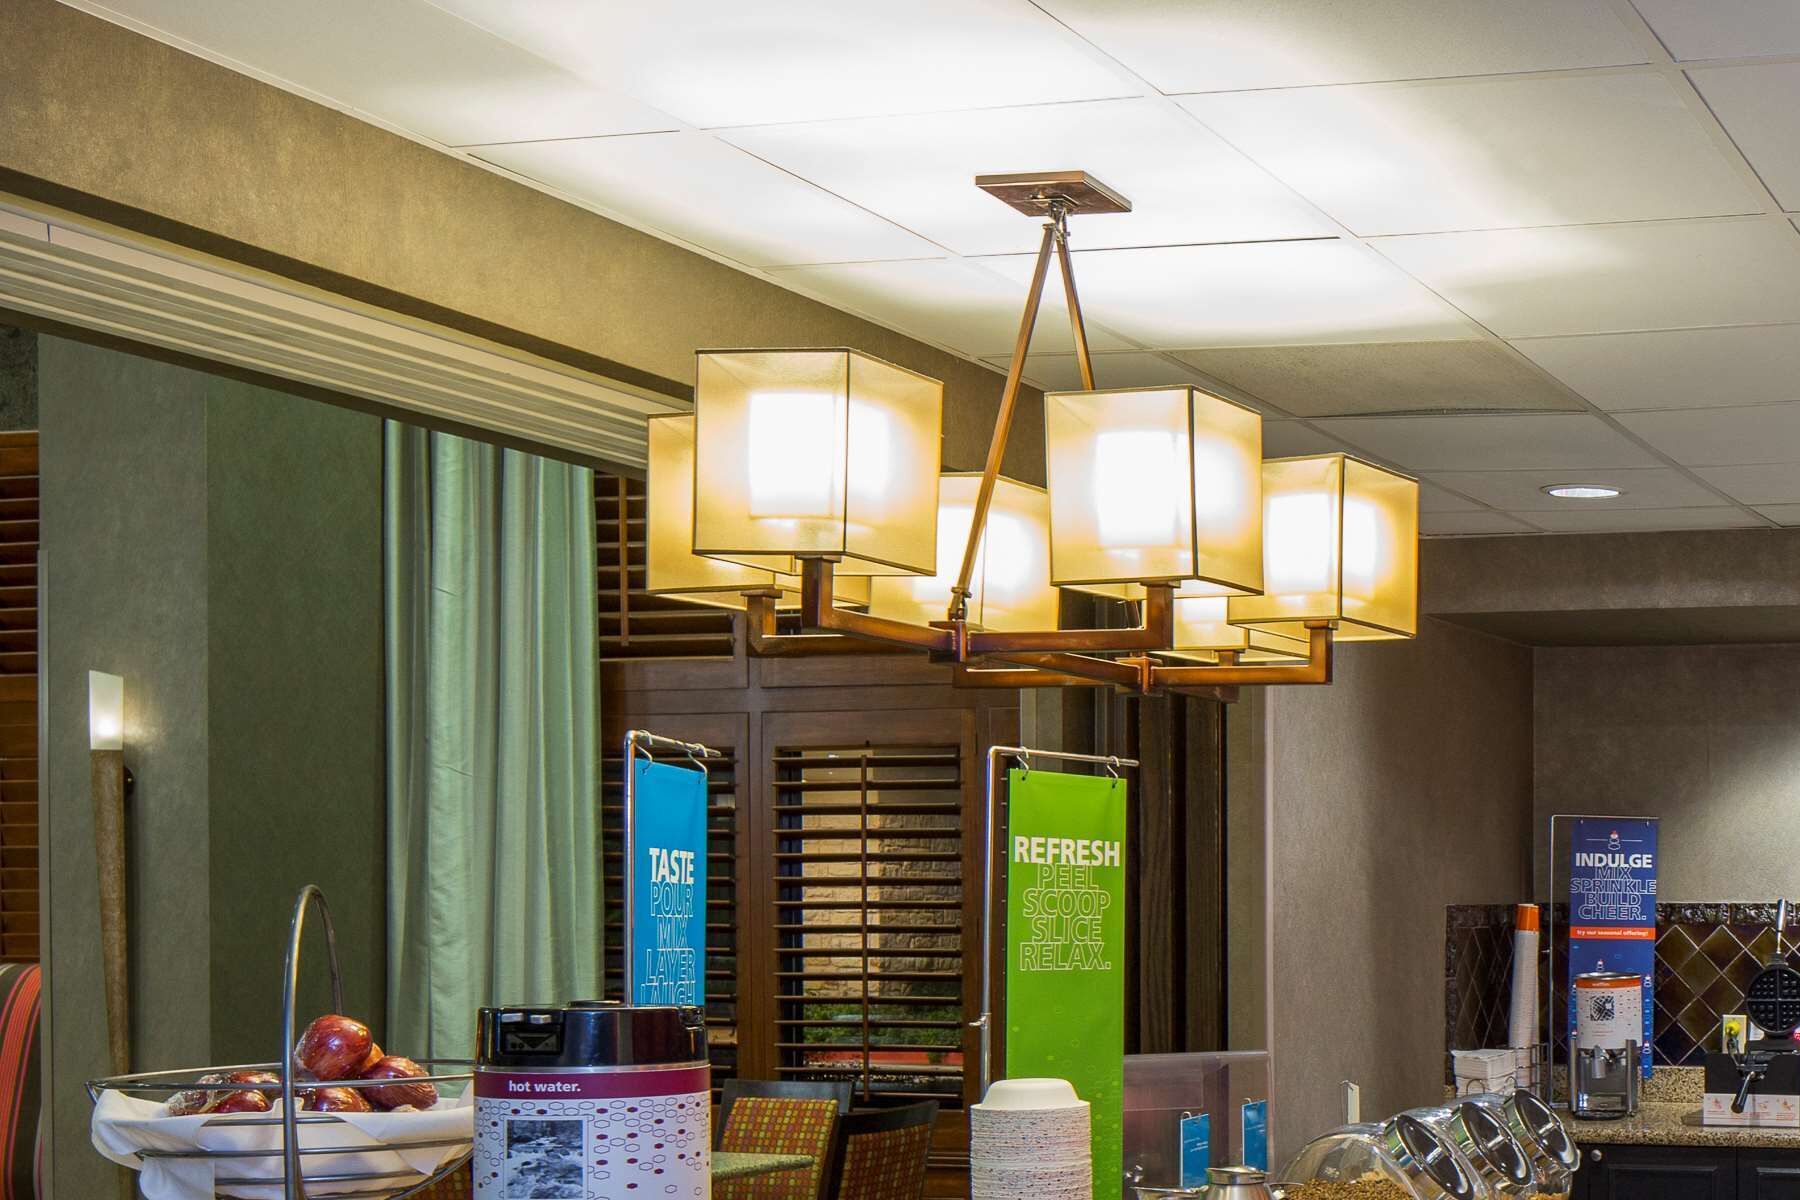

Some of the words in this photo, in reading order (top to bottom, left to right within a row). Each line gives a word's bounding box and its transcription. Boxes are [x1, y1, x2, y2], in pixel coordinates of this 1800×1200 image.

[648, 847, 694, 884] TASTE
[1014, 836, 1120, 867] REFRESH
[1575, 852, 1653, 868] INDULGE
[1037, 863, 1099, 891] PEEL
[1570, 878, 1656, 894] SPRINKLE
[1594, 866, 1633, 880] MIX
[650, 881, 694, 917] POUR
[1022, 889, 1111, 918] SCOOP
[1578, 905, 1647, 921] CHEER.
[1585, 892, 1641, 907] BUILD
[656, 916, 688, 950] MIX
[1031, 916, 1102, 944] SLICE
[645, 948, 696, 986] LAYER
[1020, 942, 1112, 971] RELAX.
[508, 1079, 531, 1092] hot
[534, 1081, 582, 1092] water.
